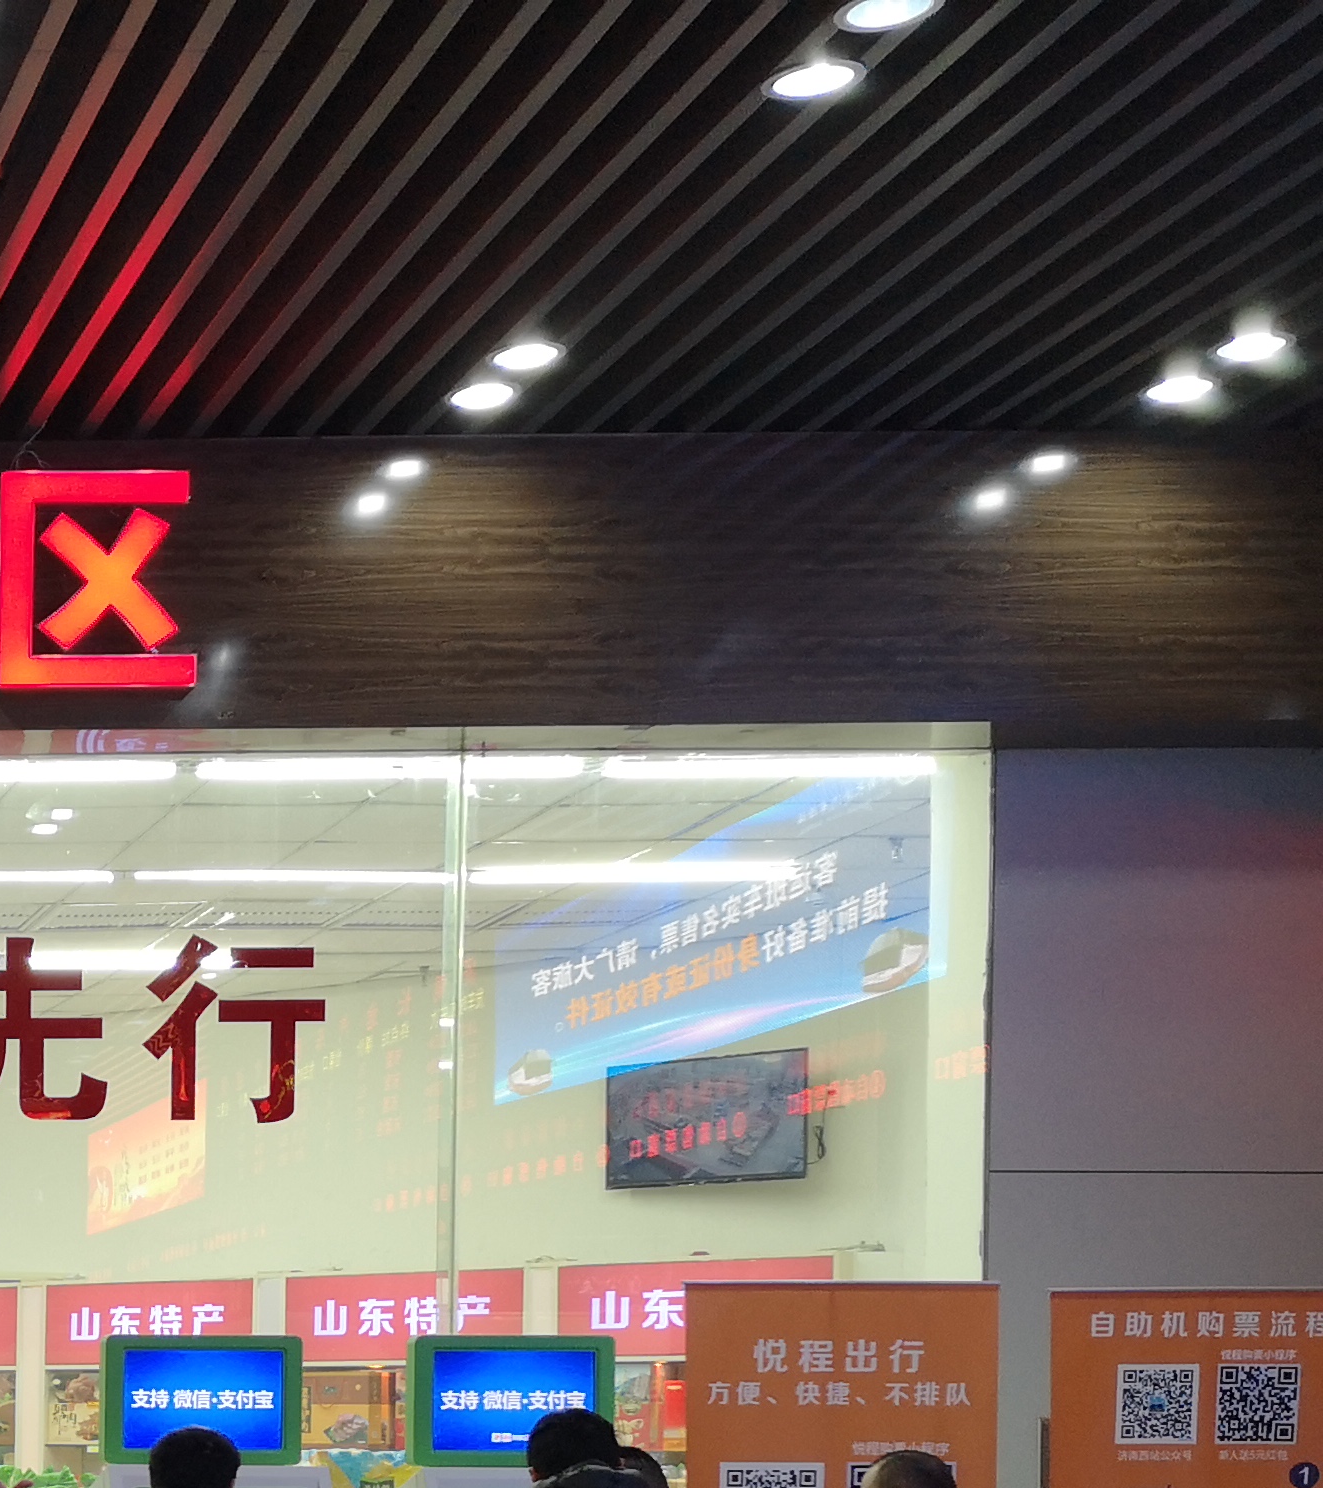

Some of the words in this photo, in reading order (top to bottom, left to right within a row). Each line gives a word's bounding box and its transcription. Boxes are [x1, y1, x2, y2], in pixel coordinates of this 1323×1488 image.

[70, 1304, 225, 1341] 山东特产
[1090, 1311, 1323, 1338] 自助机购票流程
[753, 1339, 925, 1374] 悦程出行
[131, 1389, 169, 1410] 支持
[173, 1389, 275, 1410] 微信·支付宝
[440, 1390, 478, 1411] 支持
[707, 1381, 971, 1407] 方便、快捷、不排队
[1299, 1466, 1311, 1486] 1
